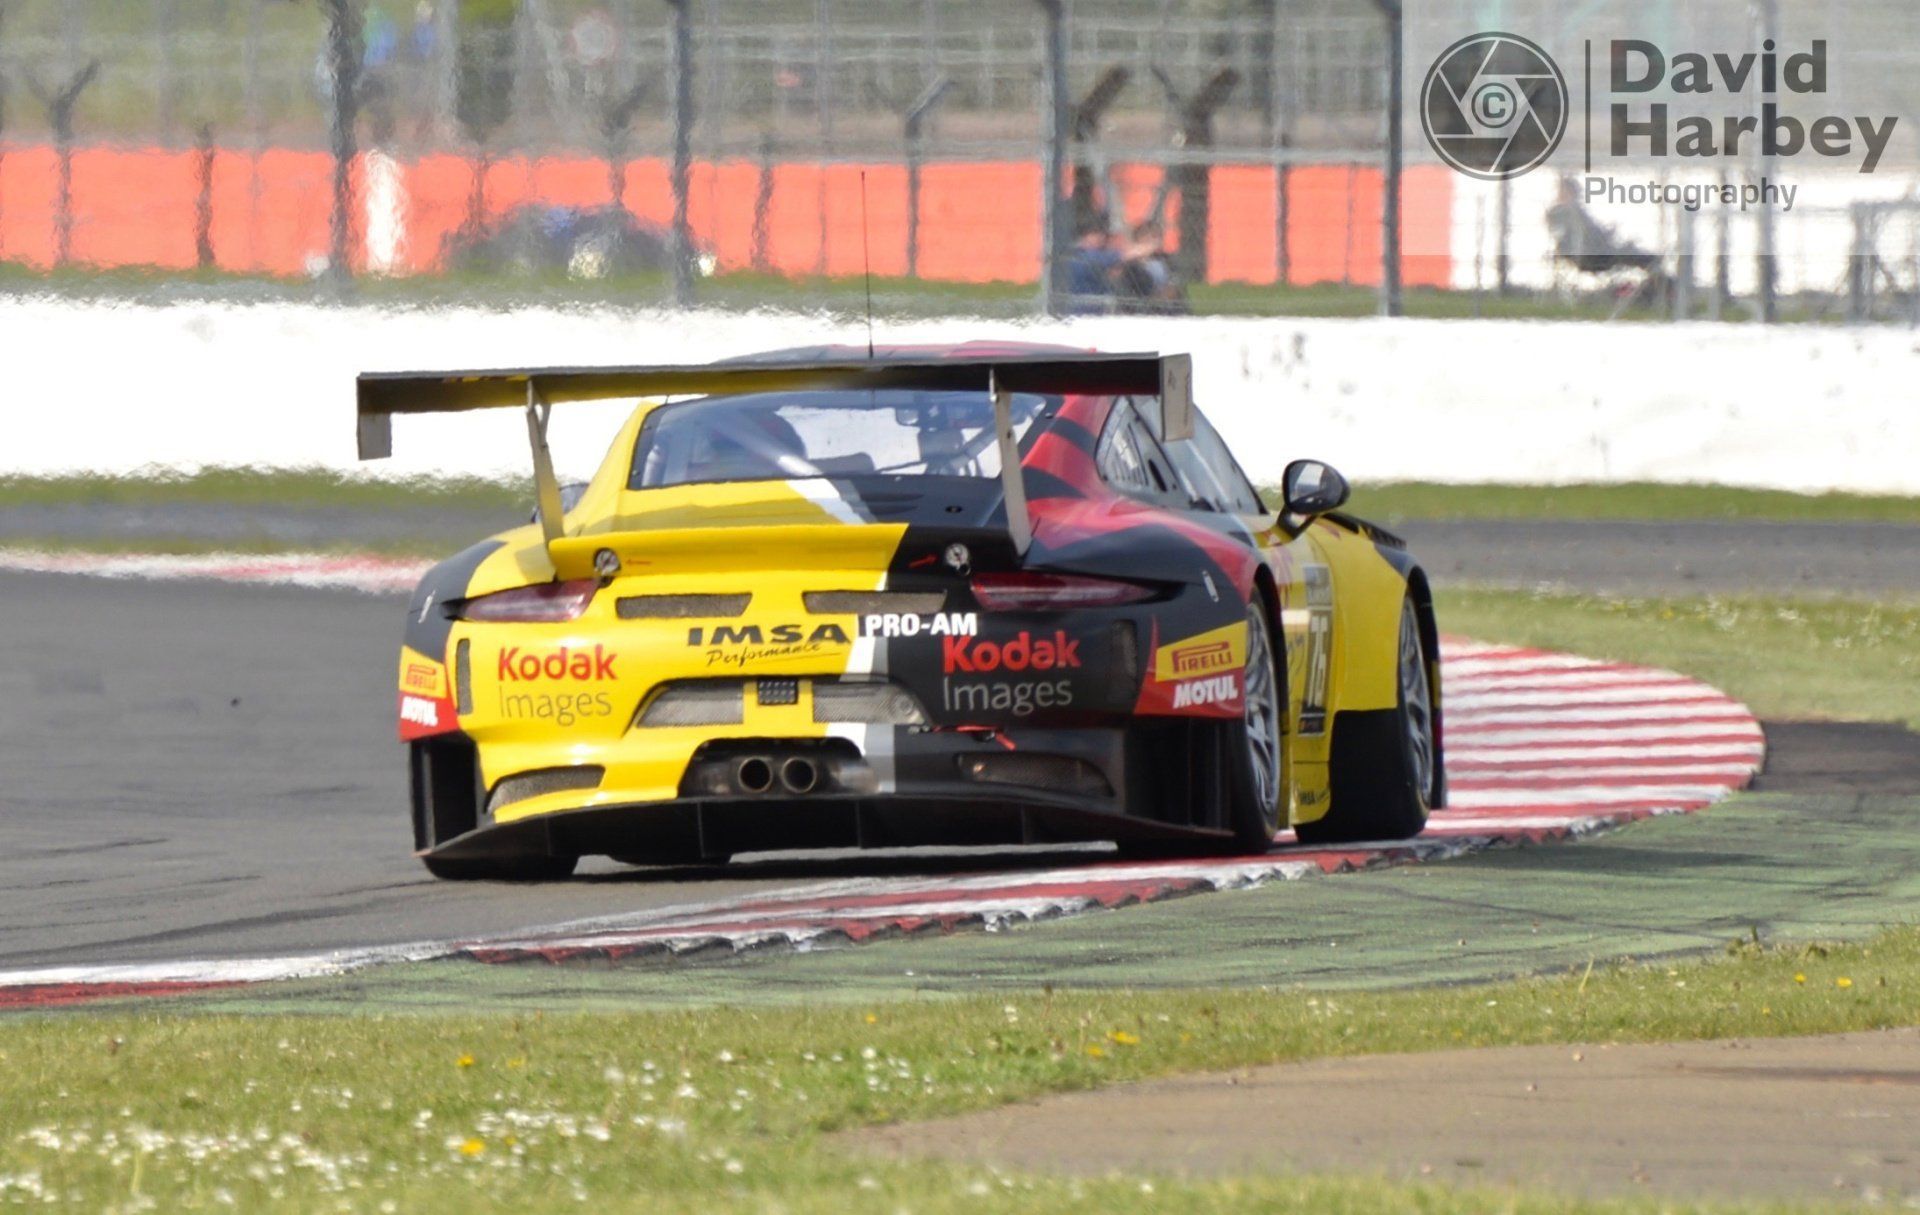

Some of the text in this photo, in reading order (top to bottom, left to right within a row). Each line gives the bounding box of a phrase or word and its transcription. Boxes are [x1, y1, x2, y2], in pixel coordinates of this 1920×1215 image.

[688, 623, 852, 647] IMSA
[865, 612, 978, 638] PRO-AM
[497, 643, 618, 681] Kodak
[943, 630, 1080, 674] Kodak
[1172, 640, 1233, 675] PIRELLI
[499, 685, 612, 727] Images
[942, 677, 1073, 716] Images
[1173, 674, 1239, 709] MOTUL
